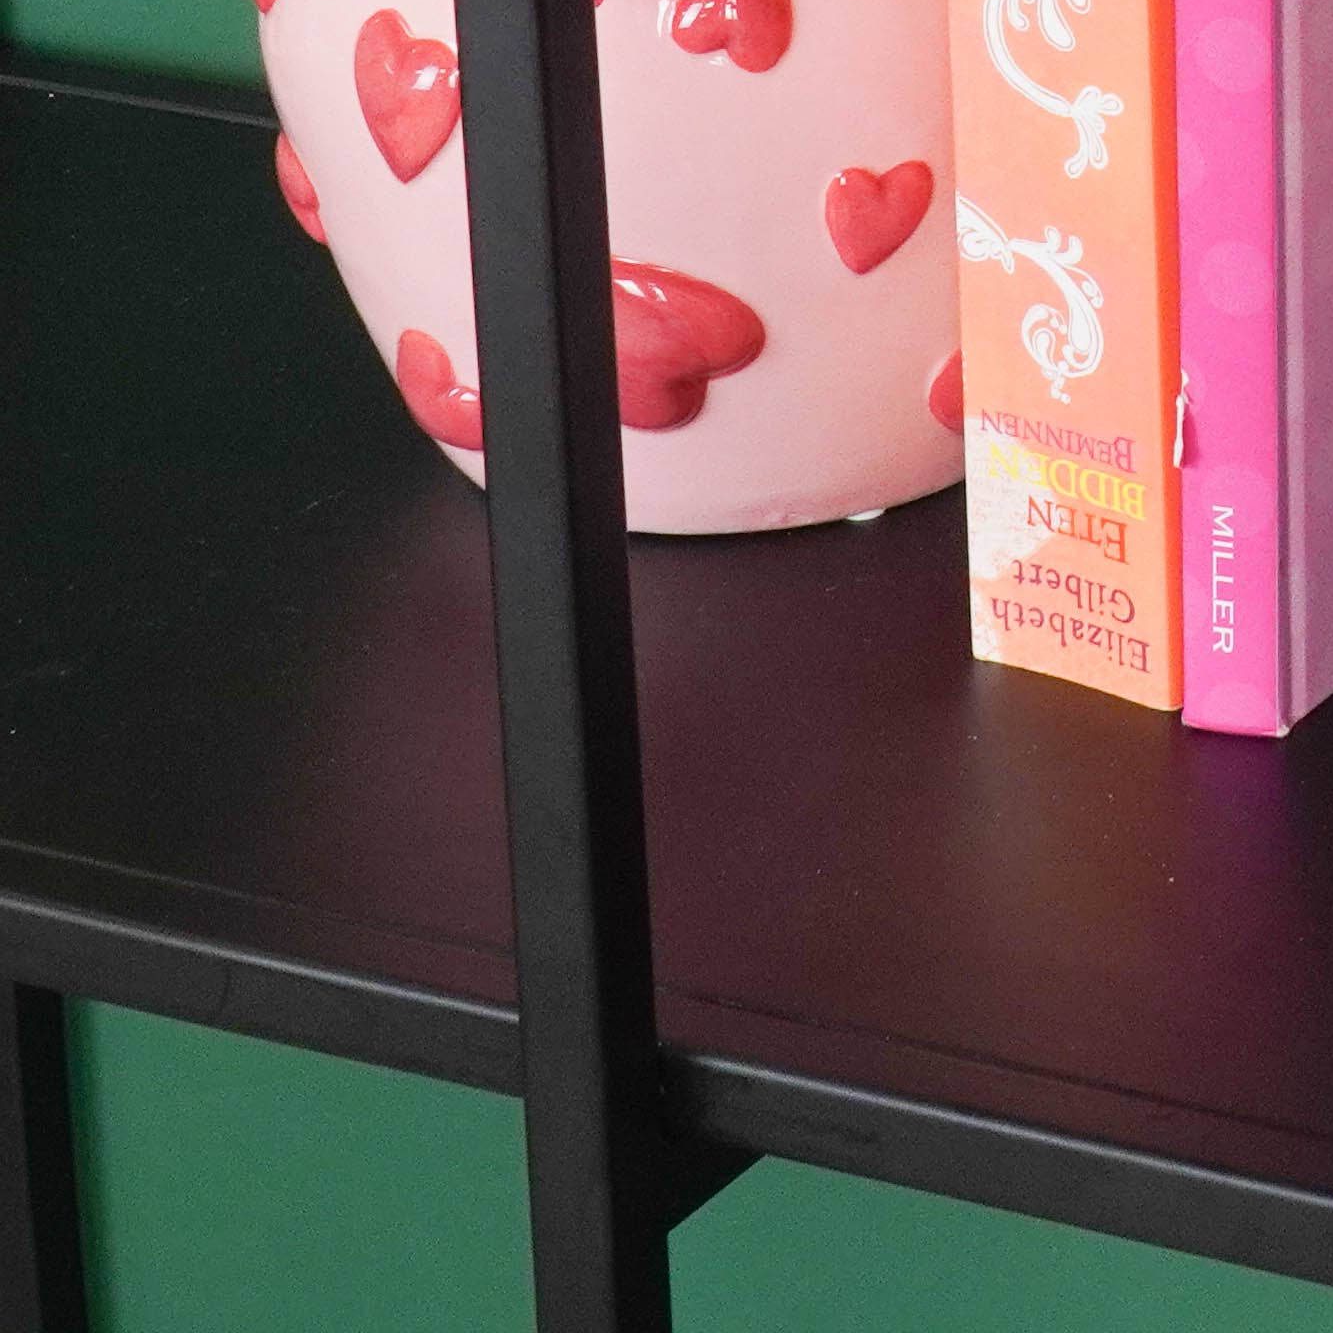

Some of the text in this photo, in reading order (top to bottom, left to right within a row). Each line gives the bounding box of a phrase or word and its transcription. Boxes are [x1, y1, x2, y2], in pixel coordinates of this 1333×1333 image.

[981, 409, 1137, 474] BEMINNEN
[988, 442, 1147, 521] BIDDEN
[1027, 495, 1130, 565] ETEN
[1012, 559, 1136, 624] Gilbert
[1212, 504, 1235, 653] MILLER
[989, 597, 1151, 674] Elizabeth
